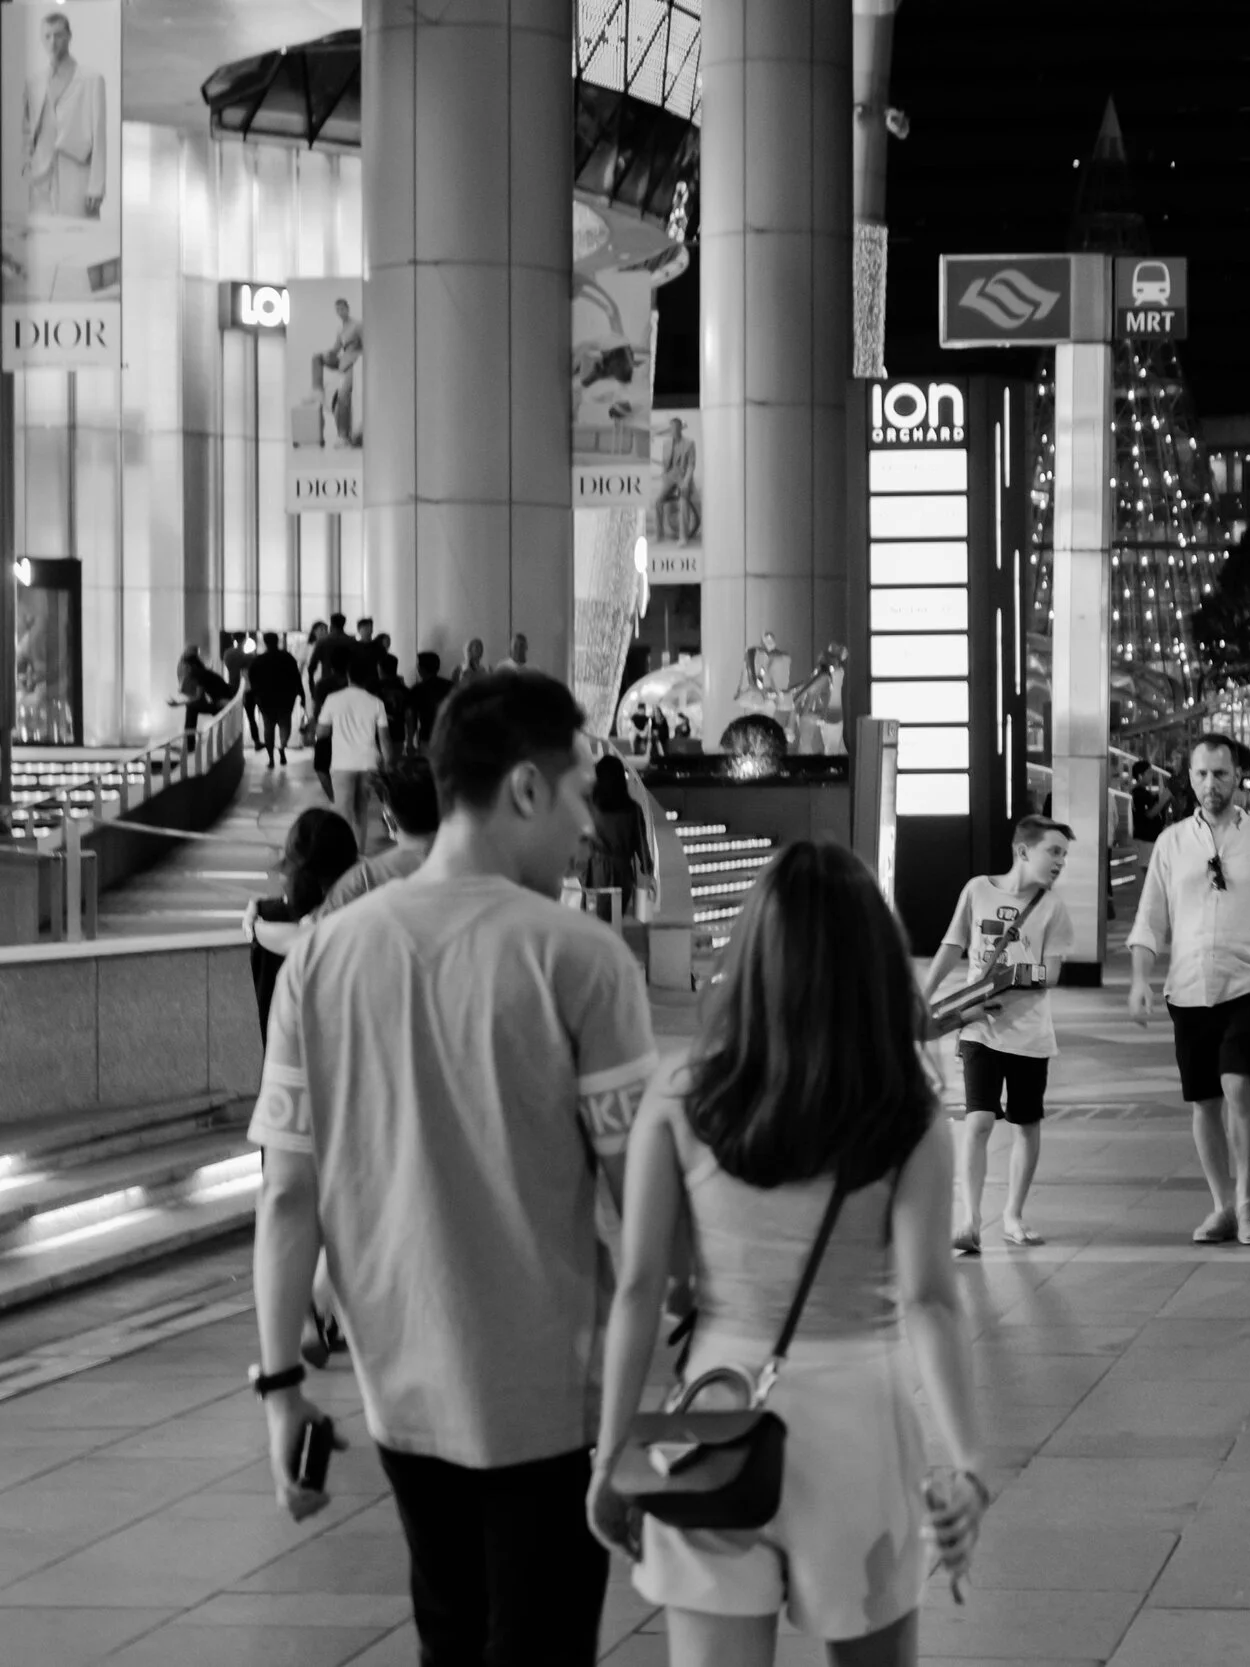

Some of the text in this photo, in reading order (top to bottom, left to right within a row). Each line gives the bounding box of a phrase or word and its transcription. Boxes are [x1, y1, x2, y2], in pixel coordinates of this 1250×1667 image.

[1126, 311, 1175, 332] MRT
[14, 319, 107, 349] DIOR
[872, 426, 964, 443] ORCHARD
[296, 478, 358, 497] DIOR
[580, 475, 642, 495] DIOR
[652, 557, 697, 573] DIOR
